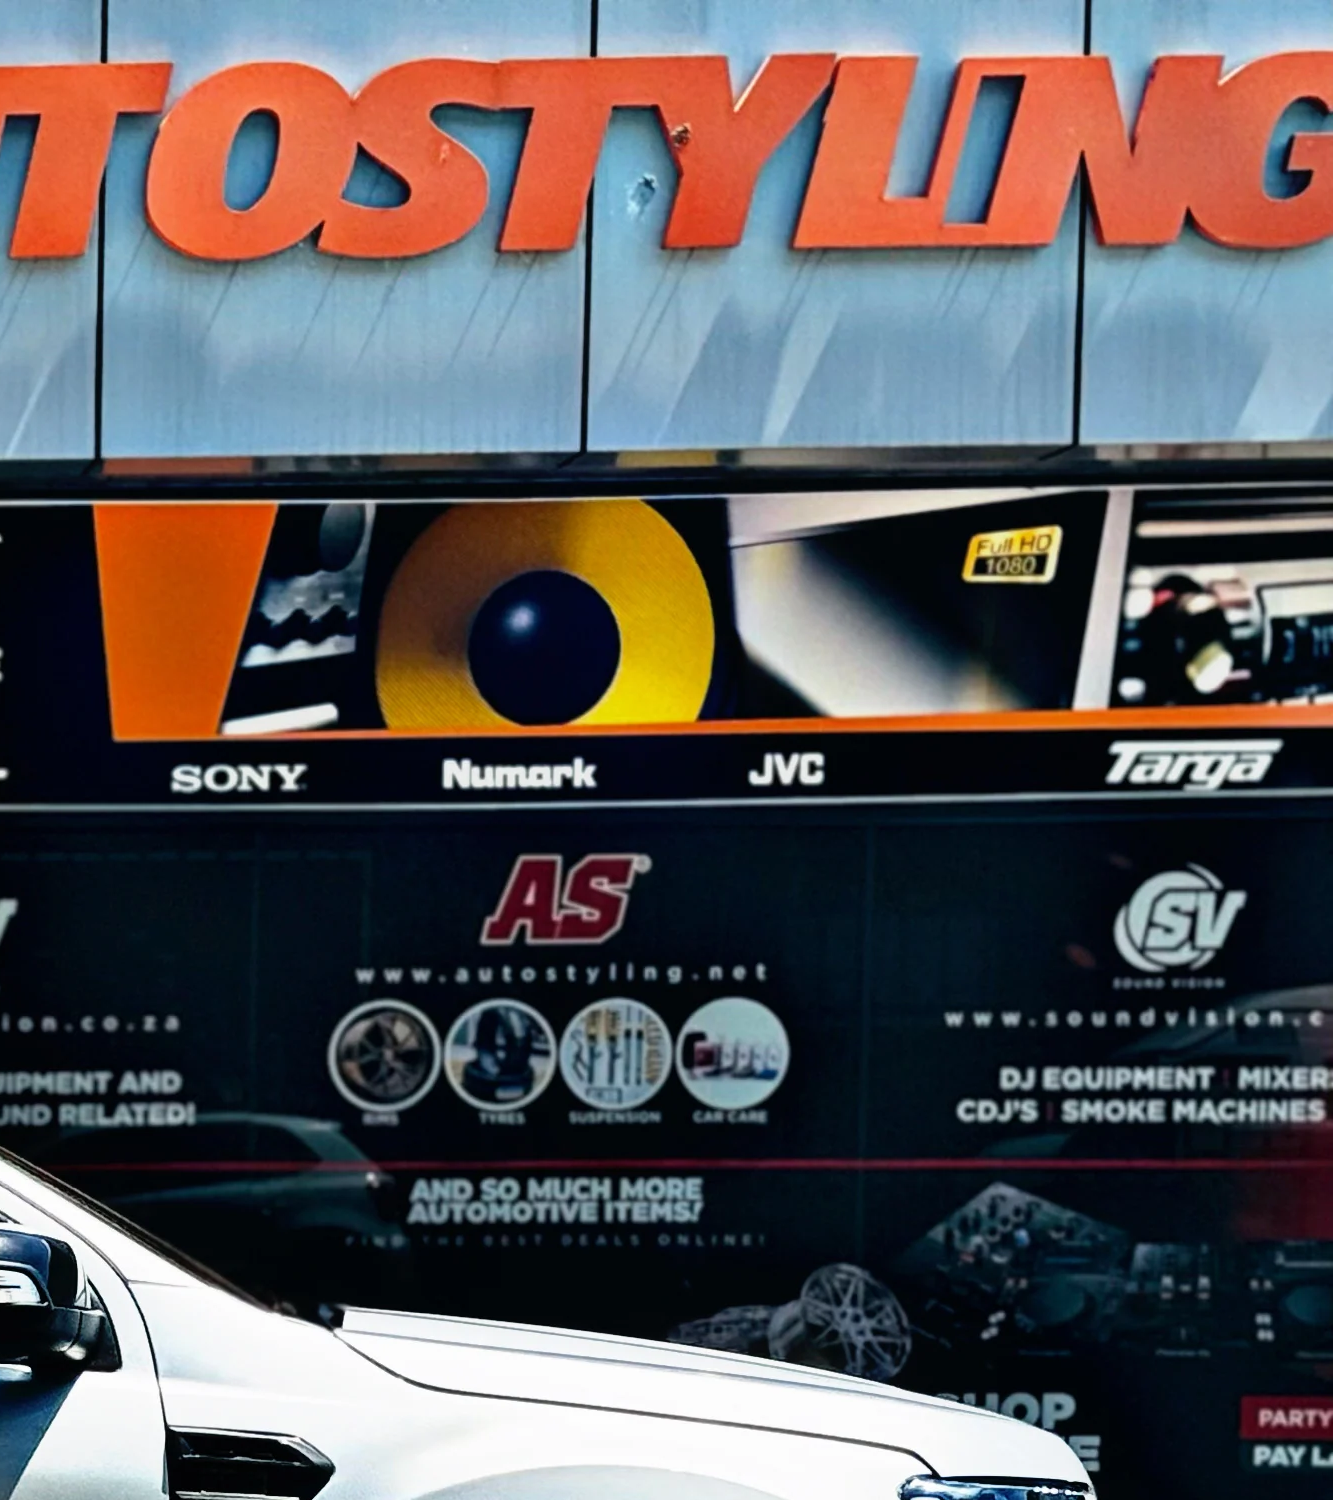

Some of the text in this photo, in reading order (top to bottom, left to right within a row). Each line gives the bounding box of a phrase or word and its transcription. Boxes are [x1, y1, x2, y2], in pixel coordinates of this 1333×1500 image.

[976, 533, 1053, 555] Full HD
[986, 556, 1038, 575] 1080
[441, 757, 598, 790] Numark
[749, 753, 825, 786] JVC
[1104, 738, 1285, 792] Targa
[171, 764, 308, 793] SONY
[1141, 891, 1246, 953] SV
[355, 961, 768, 985] www.autostyling.net
[118, 1070, 182, 1095] AND
[999, 1065, 1333, 1092] DJ EQUIPMENT MIXER
[59, 1102, 196, 1126] RELATED!
[479, 1111, 526, 1126] TYRES
[569, 1110, 662, 1125] SUSPENSION
[692, 1110, 768, 1125] CAR CARE
[956, 1097, 1327, 1124] CDJ'S SMOKE MACHINES
[409, 1177, 704, 1201] AND SO MUCH MORE
[406, 1199, 704, 1224] AUTOMOTIVE ITEMS!
[1258, 1408, 1333, 1428] PARTY
[1252, 1444, 1307, 1468] PAY
